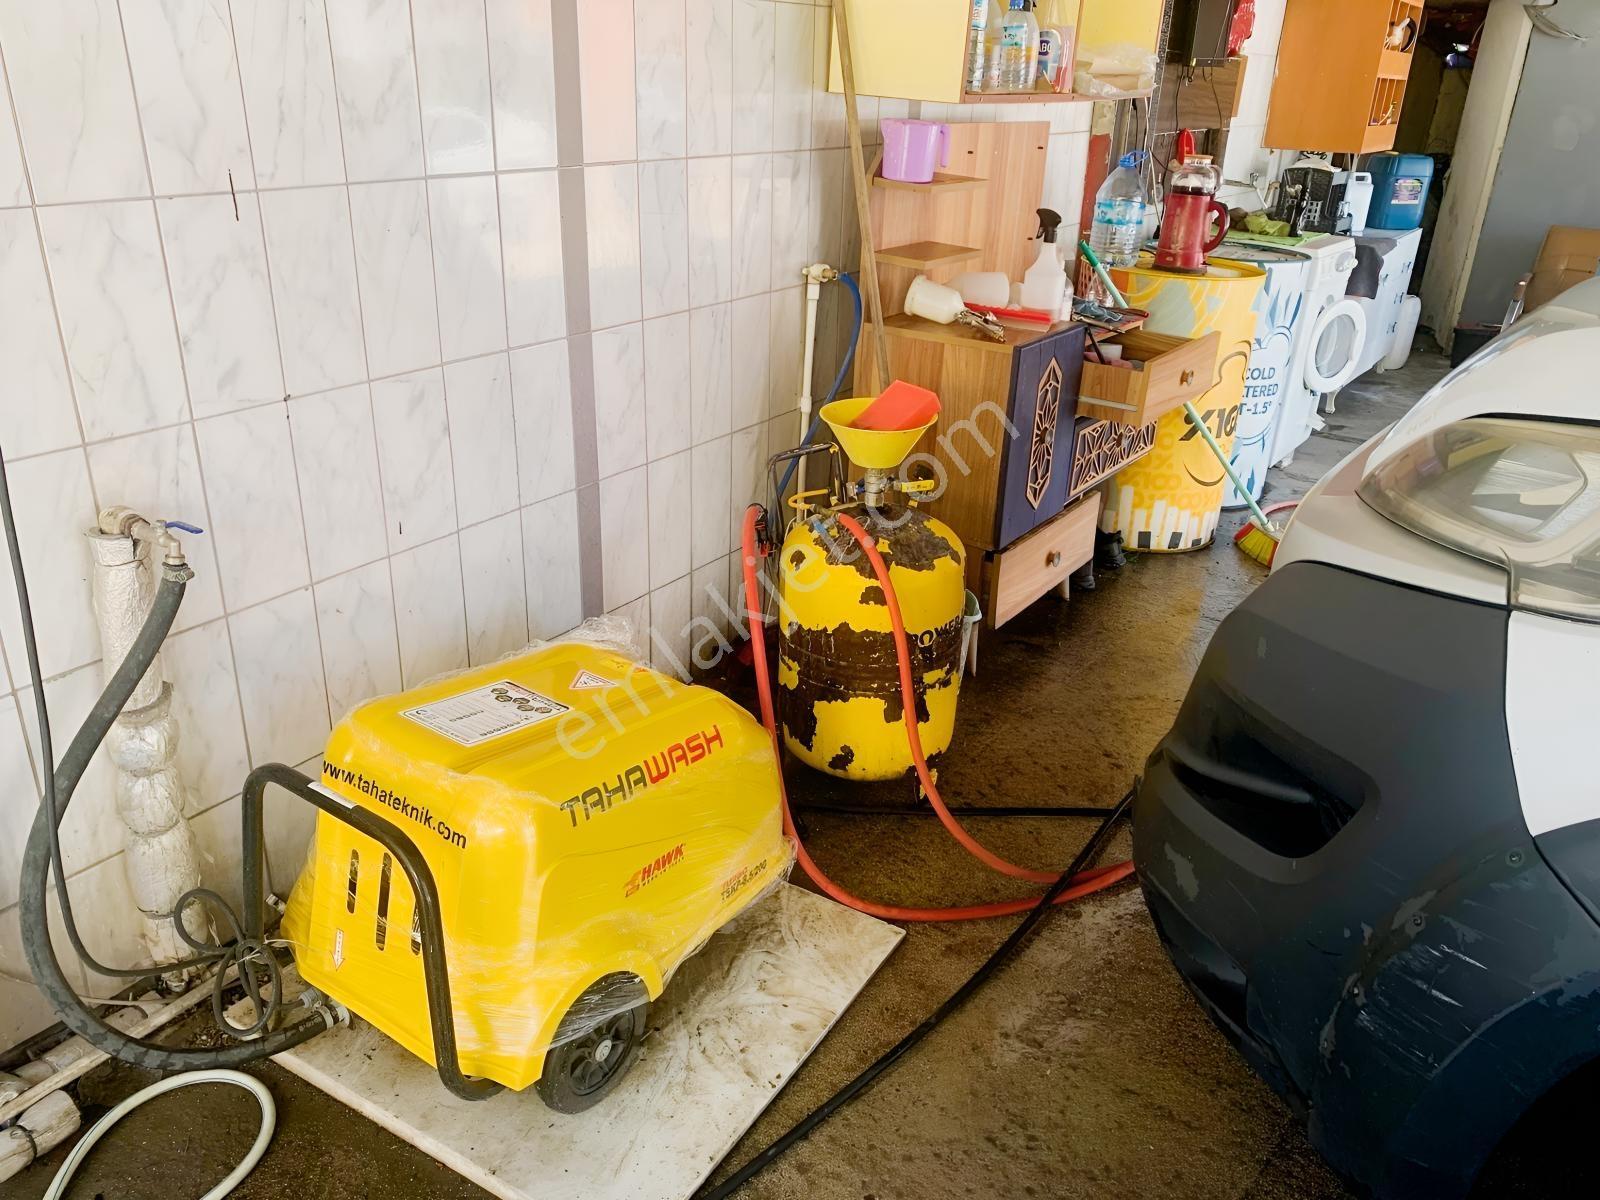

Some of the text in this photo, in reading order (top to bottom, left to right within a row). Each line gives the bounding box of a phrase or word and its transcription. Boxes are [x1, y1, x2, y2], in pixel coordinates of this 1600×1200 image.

[1242, 383, 1279, 398] TERED
[323, 760, 467, 849] www.tahateknik.com
[560, 725, 723, 827] TAHAWASH
[641, 843, 686, 881] HAWK
